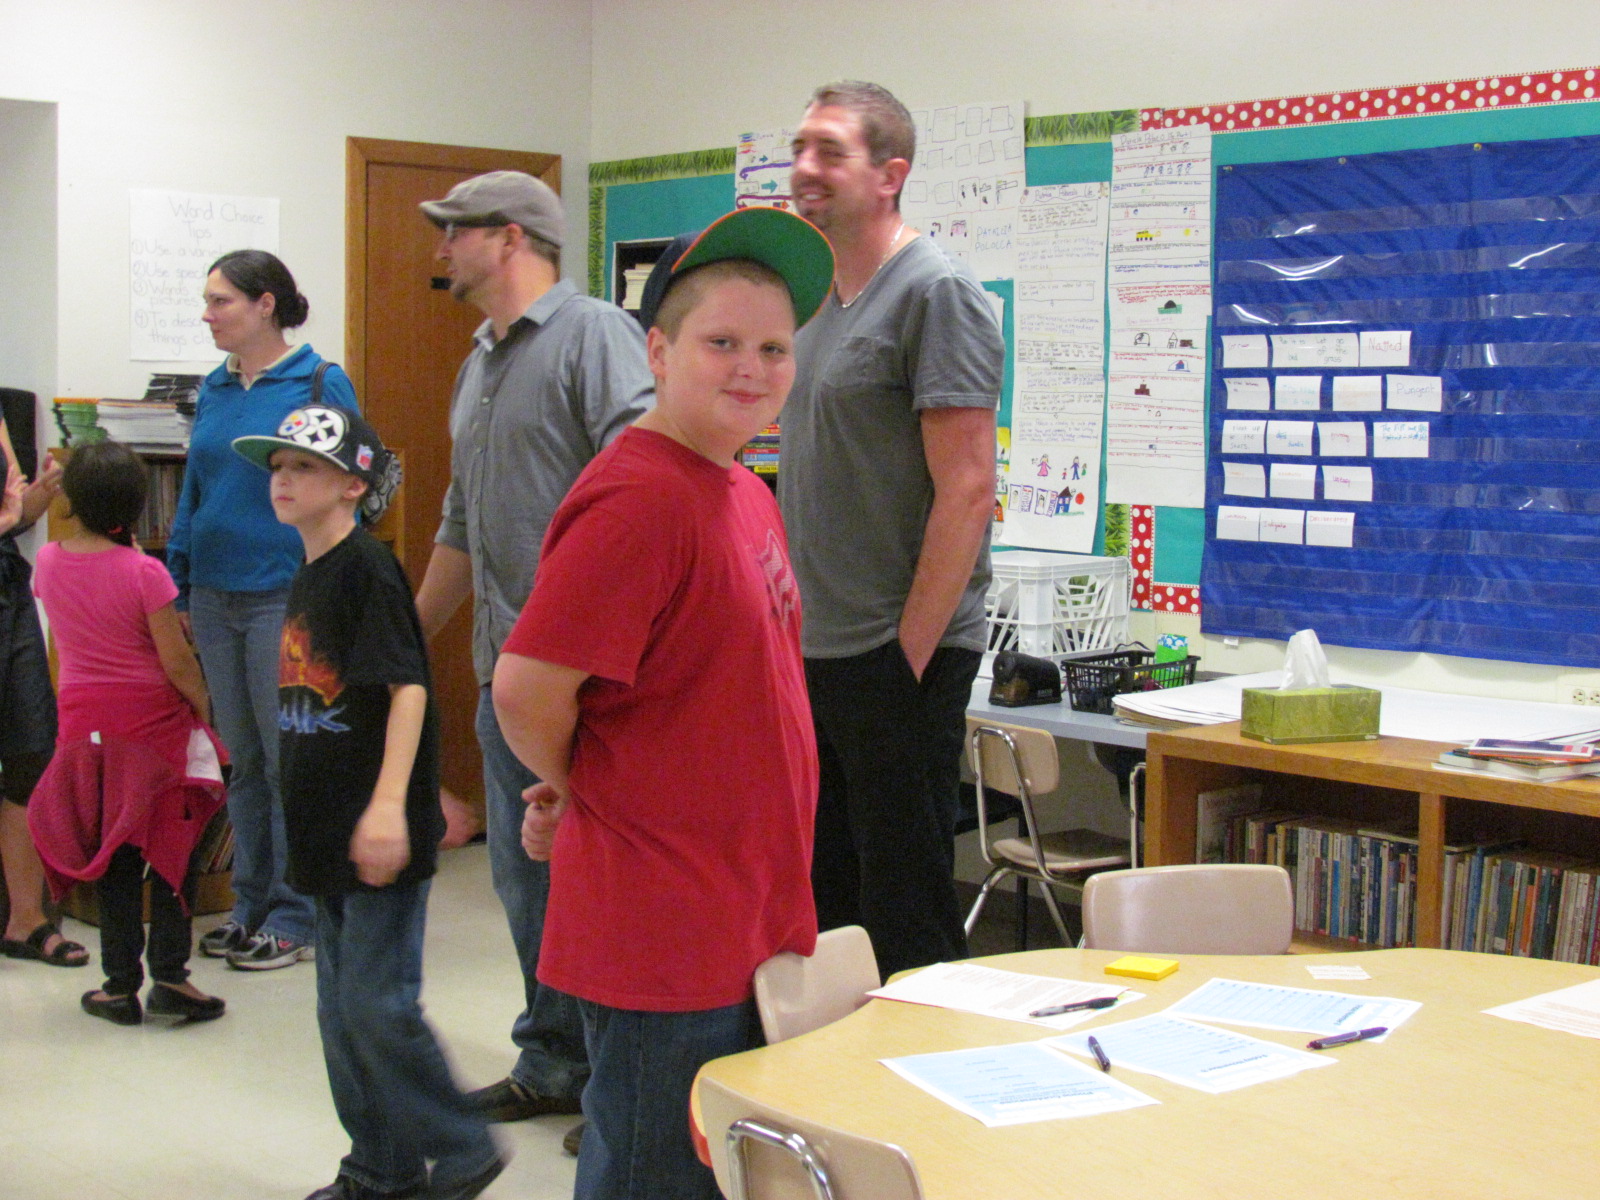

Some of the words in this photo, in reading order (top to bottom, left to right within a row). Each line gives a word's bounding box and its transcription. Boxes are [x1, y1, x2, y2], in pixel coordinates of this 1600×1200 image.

[169, 197, 214, 220] Word
[221, 202, 265, 225] Choice
[181, 219, 212, 245] Tips
[144, 239, 171, 256] Use
[146, 260, 169, 277] Use
[148, 310, 168, 328] To
[148, 328, 188, 356] things
